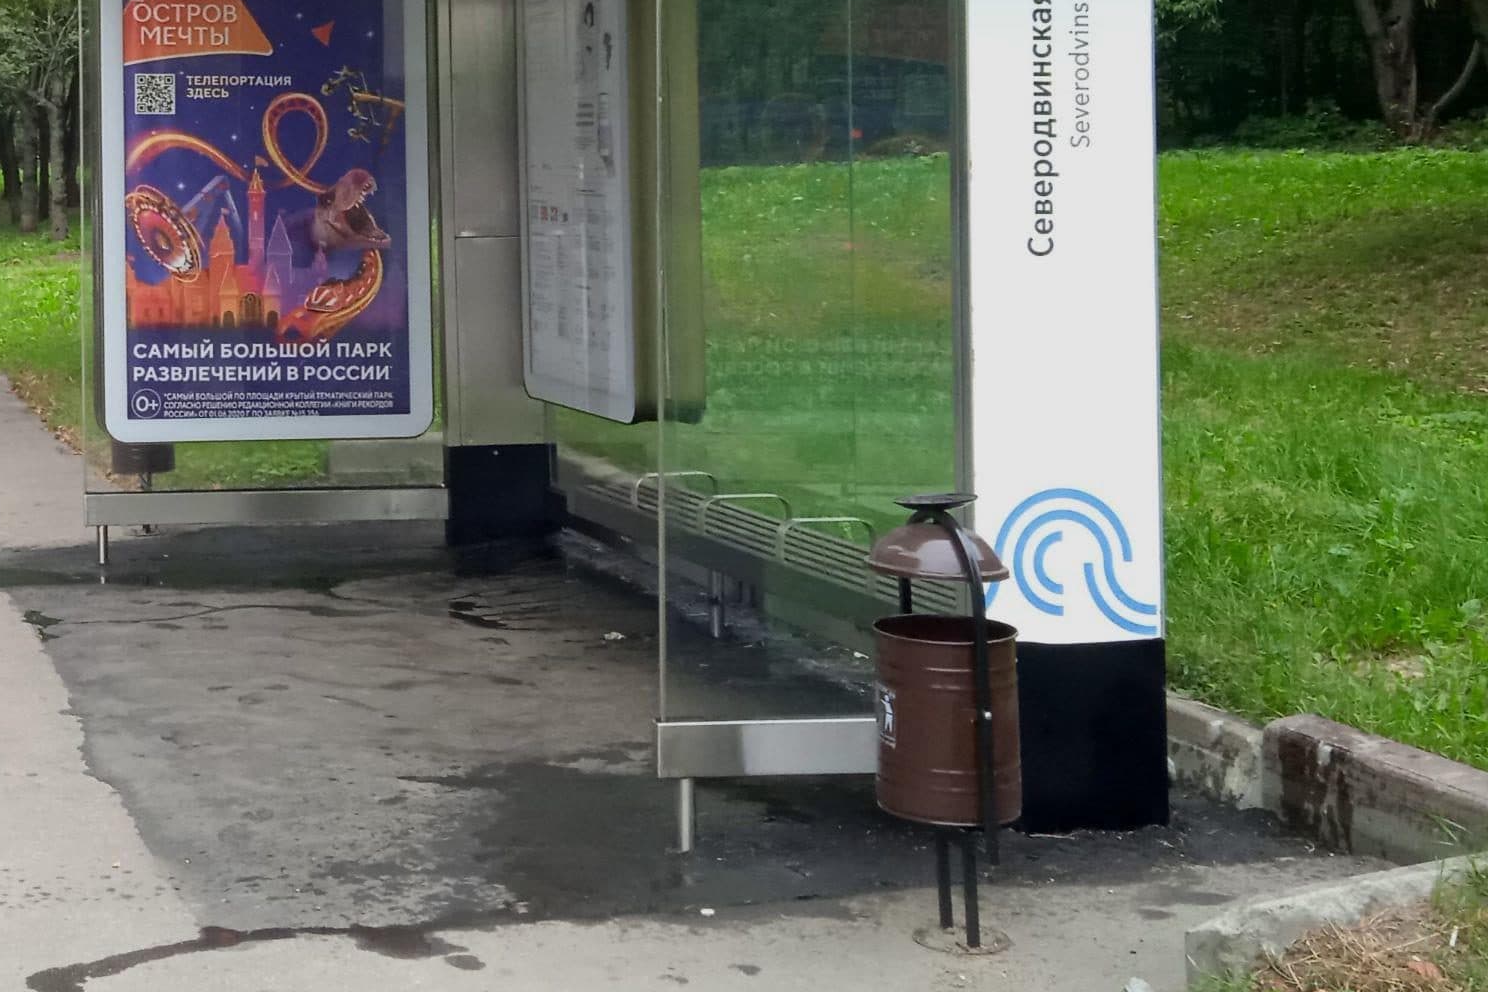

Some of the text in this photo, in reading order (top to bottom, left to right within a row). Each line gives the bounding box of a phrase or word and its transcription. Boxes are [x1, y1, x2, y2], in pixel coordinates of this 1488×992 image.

[132, 3, 238, 23] ОСТРОВ
[140, 25, 230, 46] МЕЧТЫ
[185, 75, 292, 87] ТЕЛЕПОРТАЦИЯ
[185, 87, 230, 99] ЗДЕСЬ
[132, 339, 393, 359] САМЫЙ БОЛЬШОЙ ПАРК
[132, 362, 282, 382] РАЗВЛЕЧЕНИЙ
[286, 365, 299, 381] В
